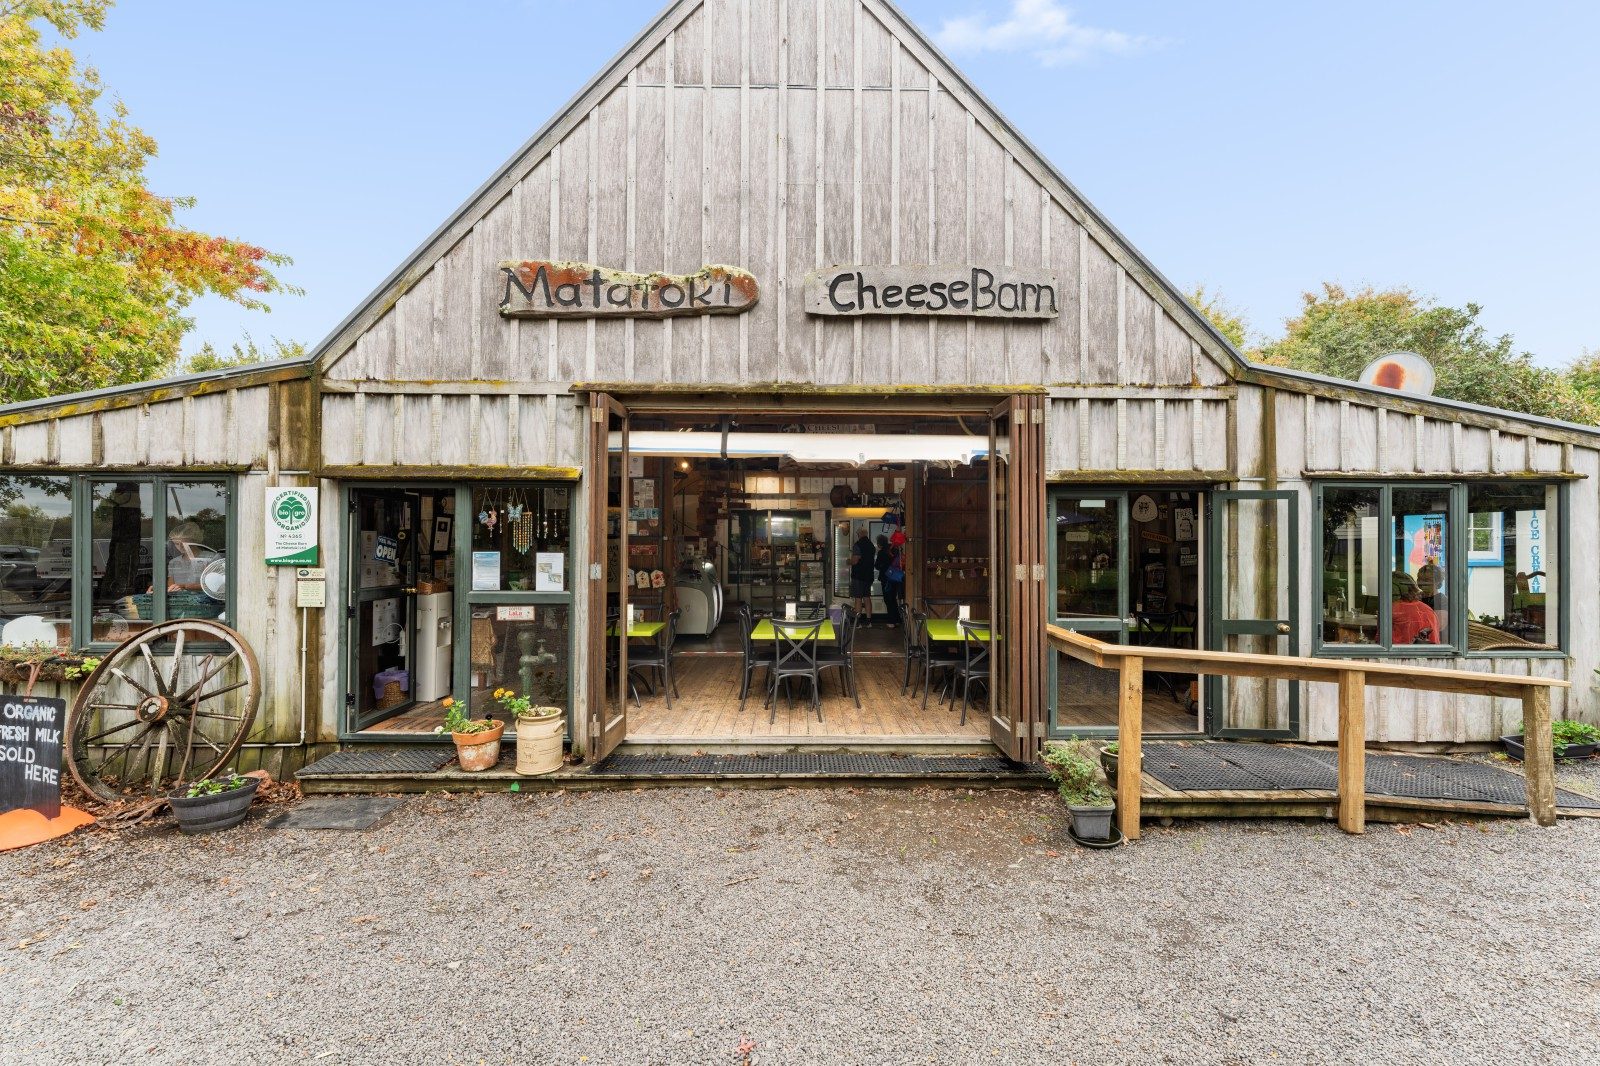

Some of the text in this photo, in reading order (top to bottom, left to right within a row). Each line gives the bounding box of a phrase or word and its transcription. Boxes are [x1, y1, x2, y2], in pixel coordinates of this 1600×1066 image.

[275, 490, 308, 502] CERTIFIED
[276, 521, 306, 531] ORGANIC
[1530, 508, 1540, 540] ICE
[376, 544, 396, 560] OPEN
[4, 703, 56, 722] ORGANIC
[35, 727, 61, 744] MILK
[0, 744, 36, 764] SOLD
[24, 763, 59, 786] HERE
